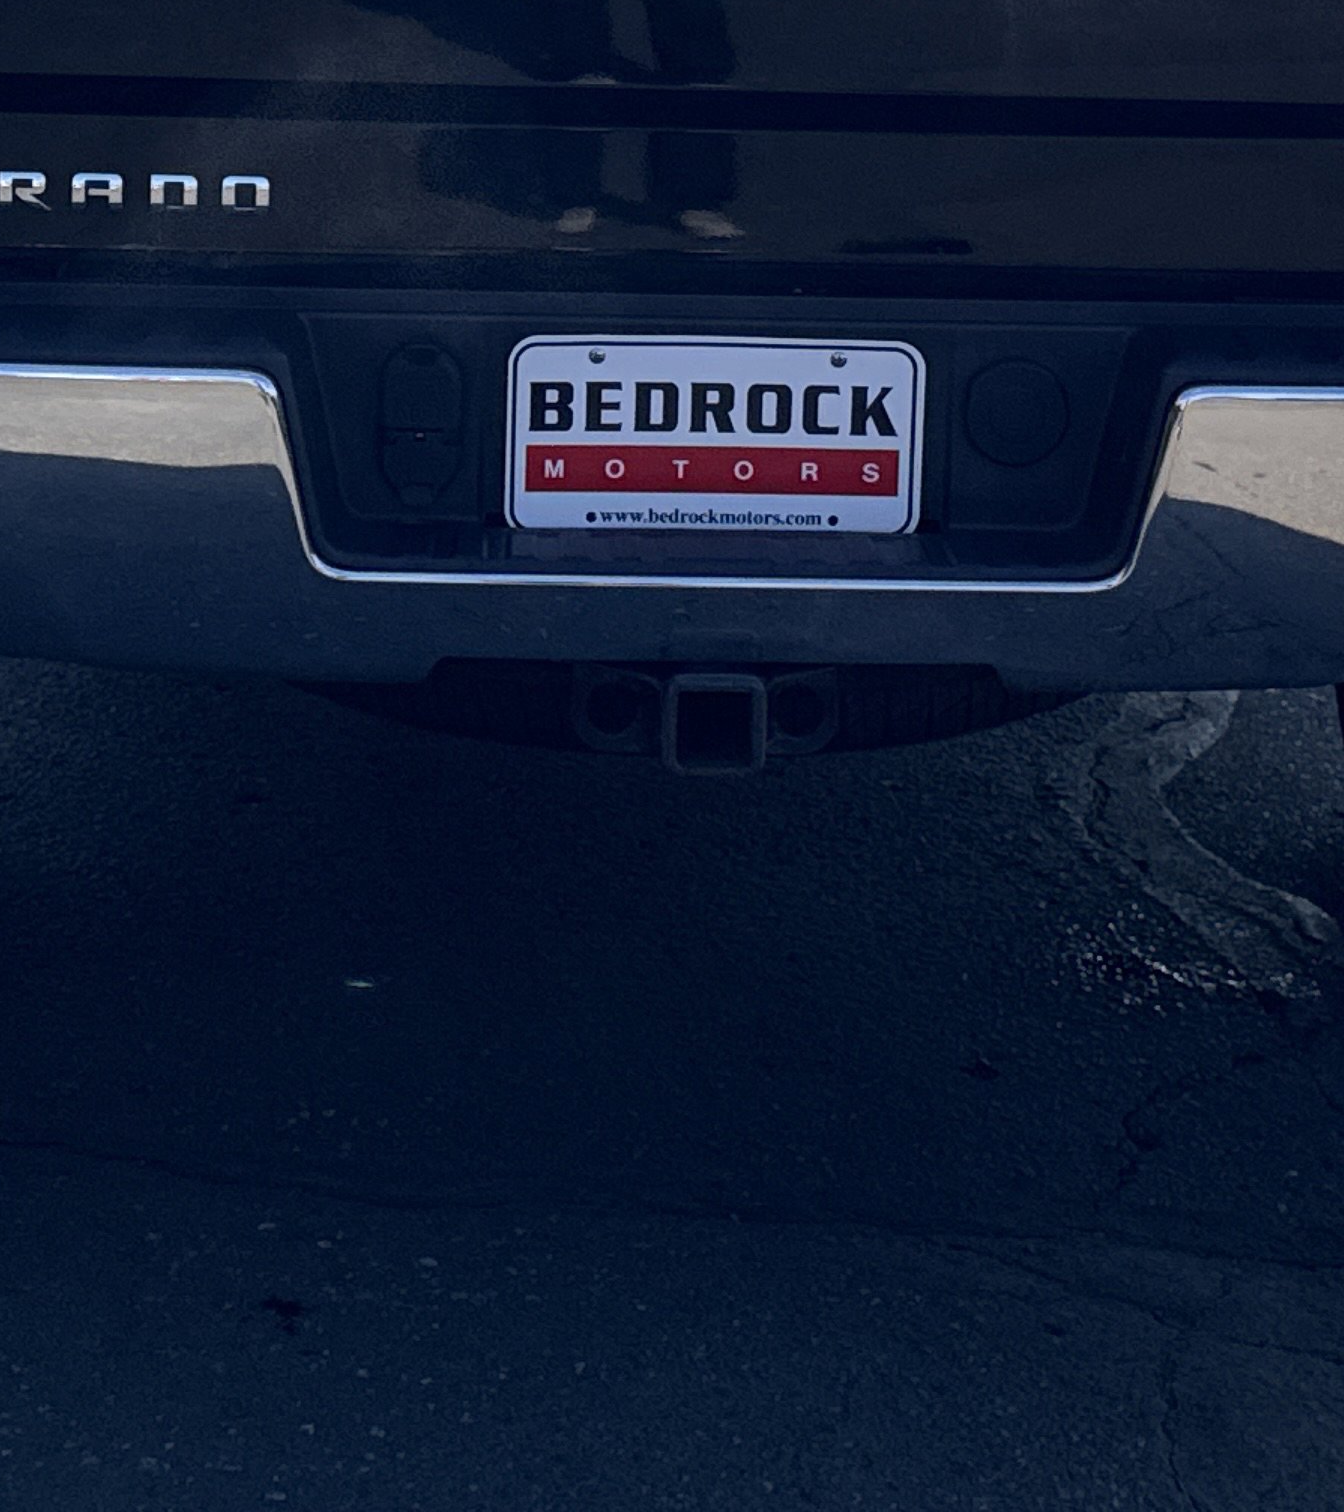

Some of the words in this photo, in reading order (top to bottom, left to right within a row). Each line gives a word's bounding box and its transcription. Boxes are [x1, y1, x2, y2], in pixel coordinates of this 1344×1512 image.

[528, 381, 898, 437] BEDROCK
[543, 458, 881, 484] MOTORS
[600, 506, 823, 527] www.bedrockmotors.com
